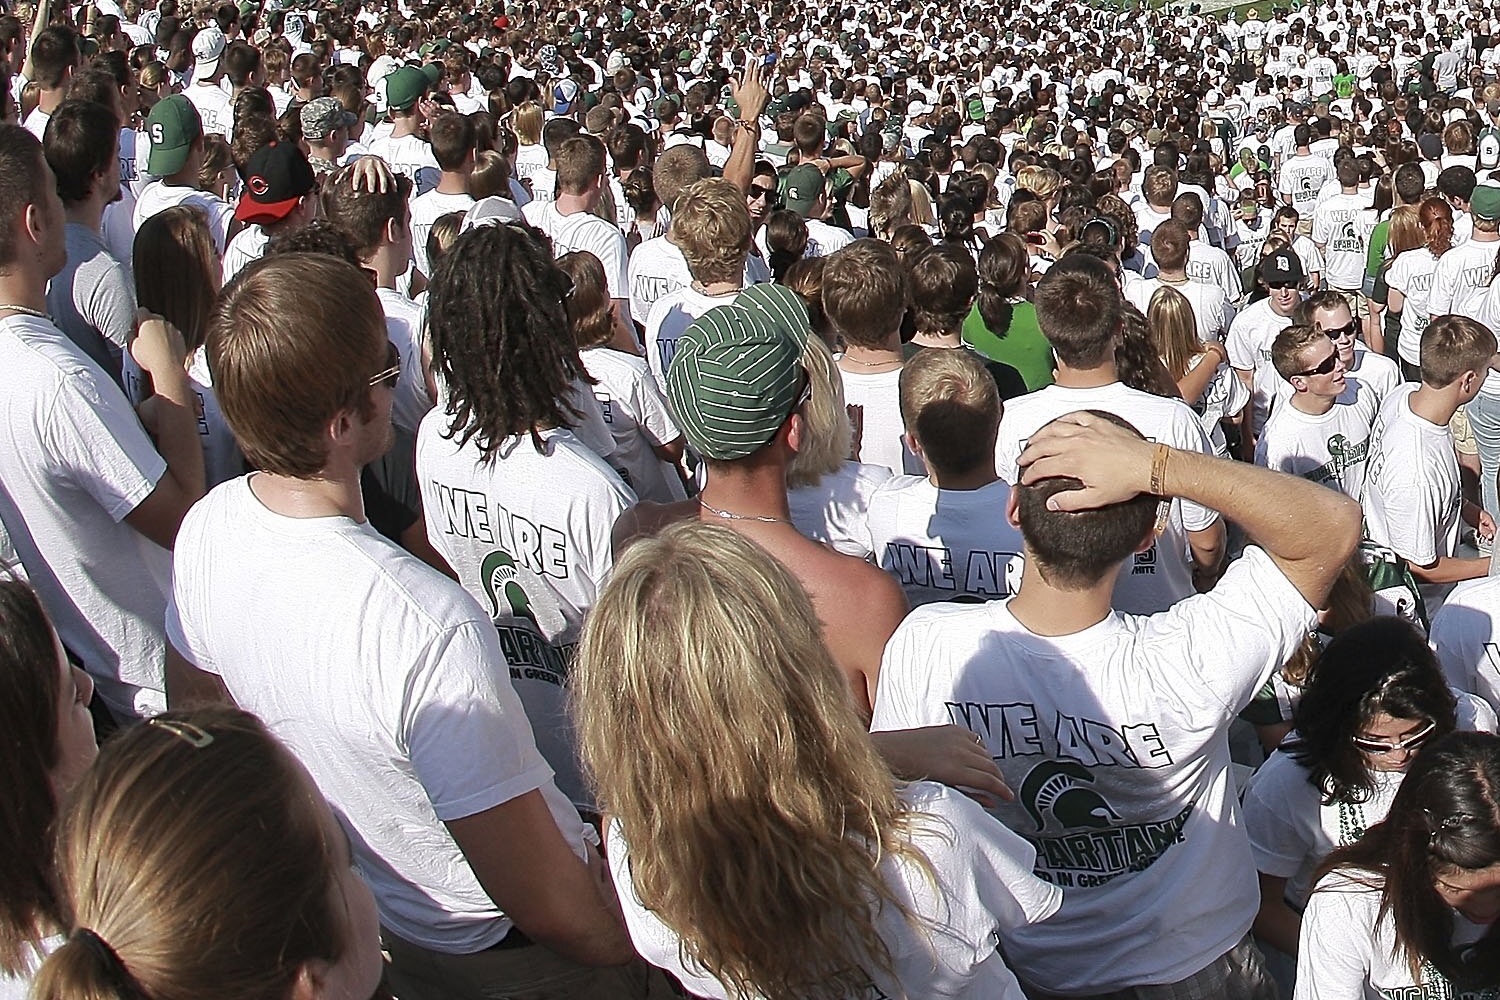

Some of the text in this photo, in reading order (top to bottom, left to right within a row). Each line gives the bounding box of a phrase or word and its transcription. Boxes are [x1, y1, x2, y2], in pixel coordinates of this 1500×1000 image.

[152, 123, 164, 144] S
[1275, 255, 1290, 272] D
[432, 480, 494, 543] WE
[887, 542, 956, 591] WE
[945, 702, 1174, 768] WE ARE
[1057, 872, 1073, 887] IN
